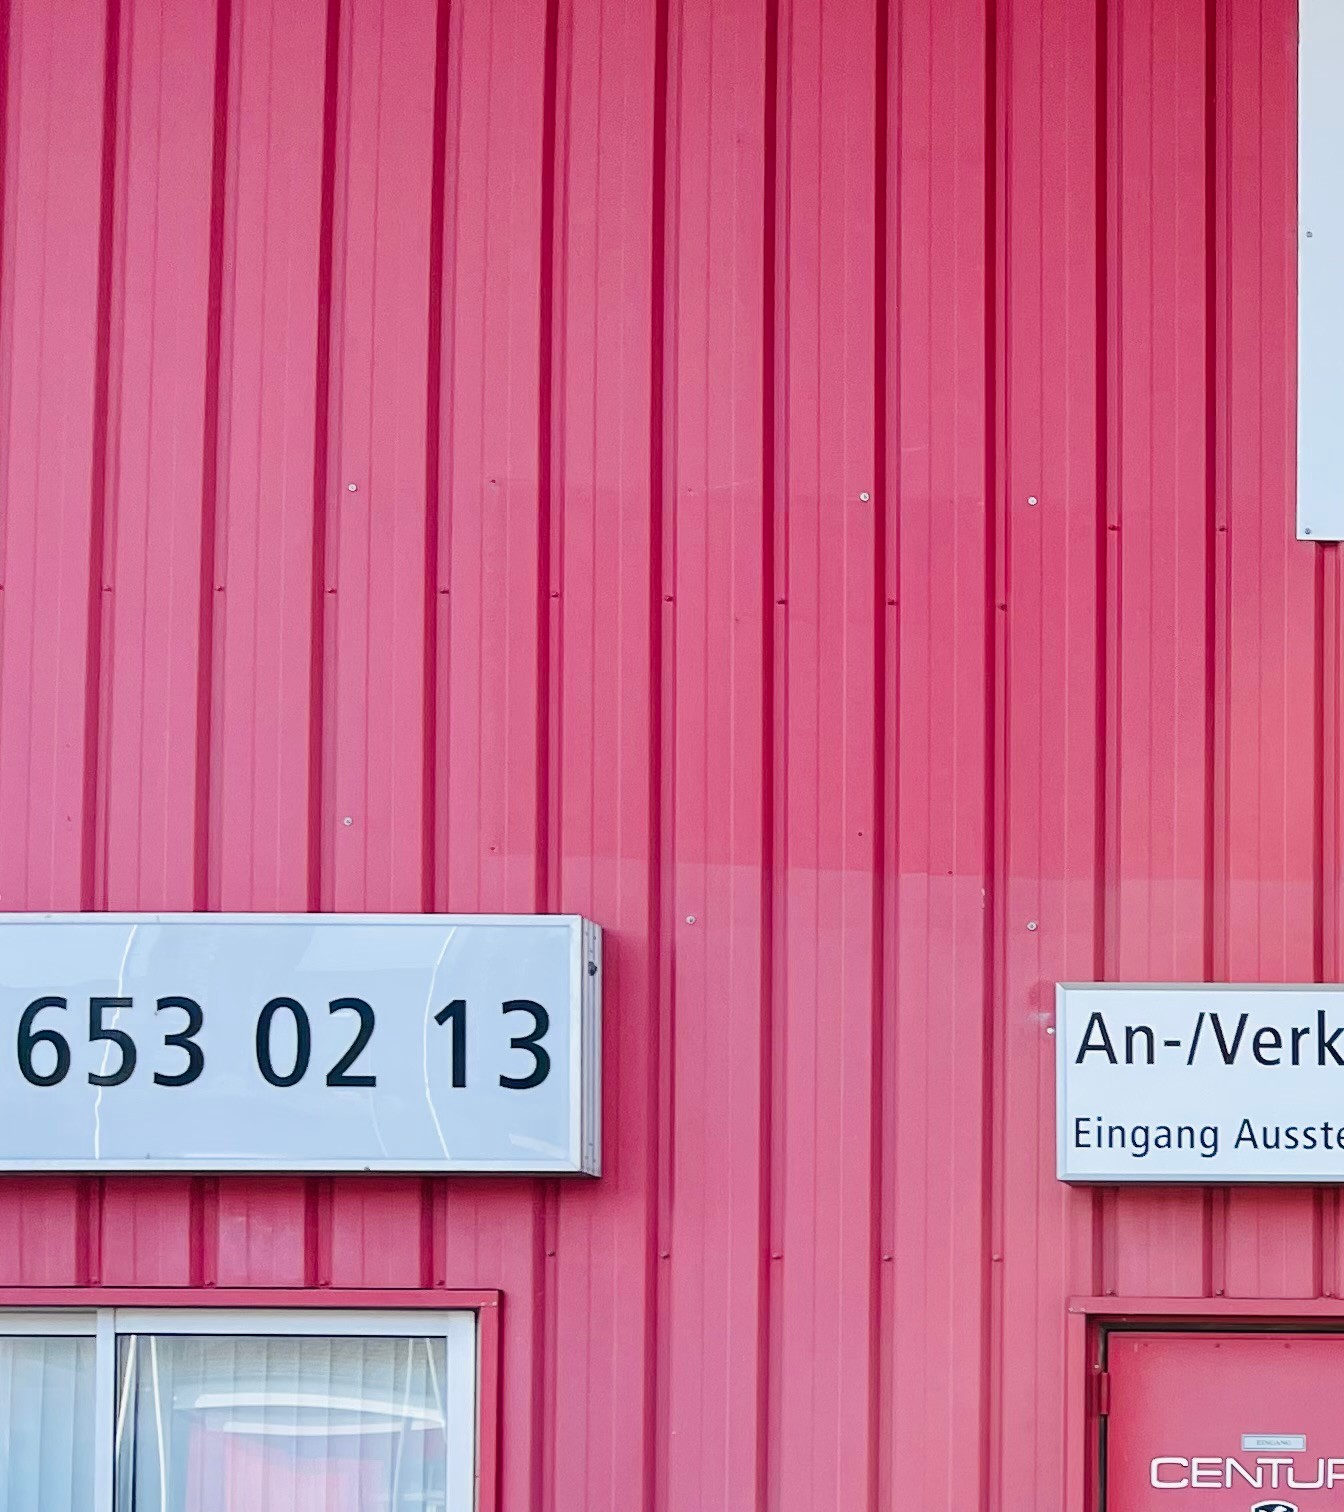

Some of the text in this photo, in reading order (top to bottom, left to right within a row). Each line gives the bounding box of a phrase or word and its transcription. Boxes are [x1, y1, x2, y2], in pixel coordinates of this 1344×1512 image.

[17, 996, 550, 1089] 653 02 13
[1076, 1117, 1218, 1157] Eingang
